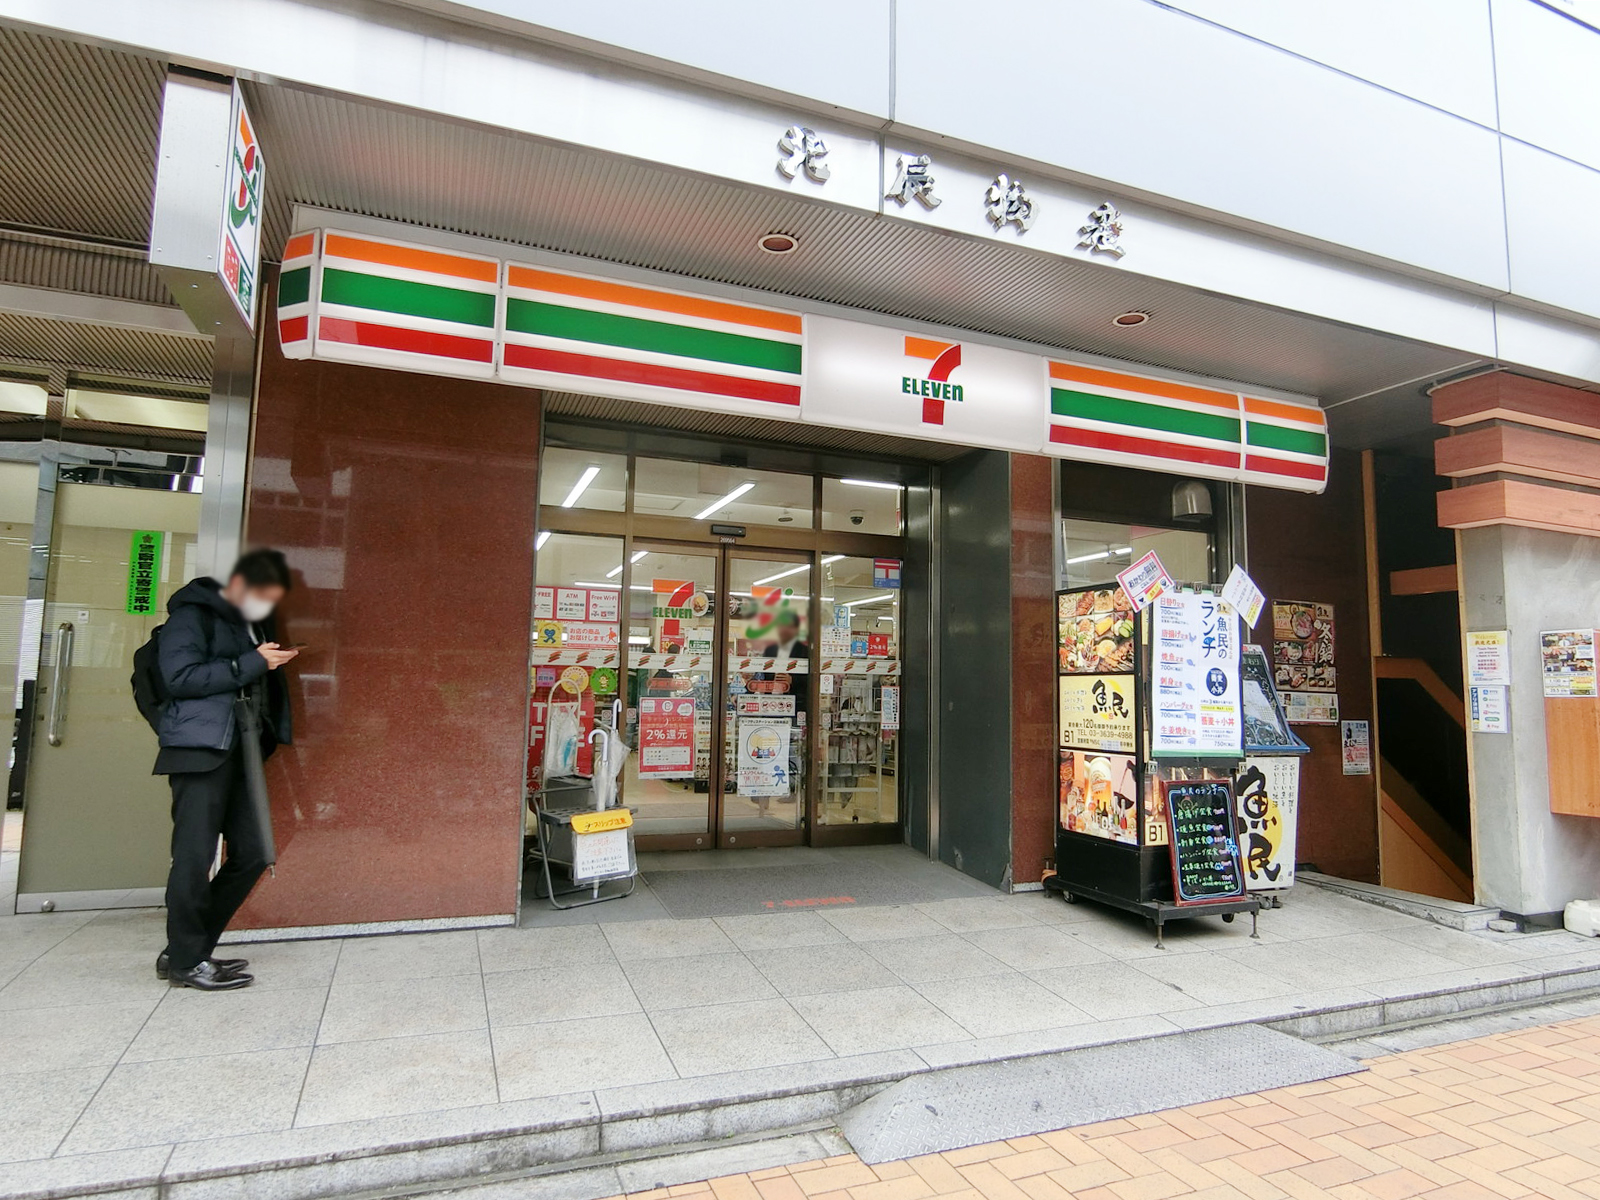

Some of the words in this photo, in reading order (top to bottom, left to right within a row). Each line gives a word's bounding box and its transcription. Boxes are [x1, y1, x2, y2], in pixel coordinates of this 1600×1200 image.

[133, 544, 155, 613] 警察官立寄警戒中
[1201, 600, 1216, 659] ランチ
[1217, 616, 1229, 659] 魚民の
[1091, 679, 1129, 719] 魚民
[646, 729, 688, 740] 2%還元
[1064, 730, 1074, 743] B1
[1149, 826, 1163, 842] B1
[1237, 765, 1281, 881] 魚民
